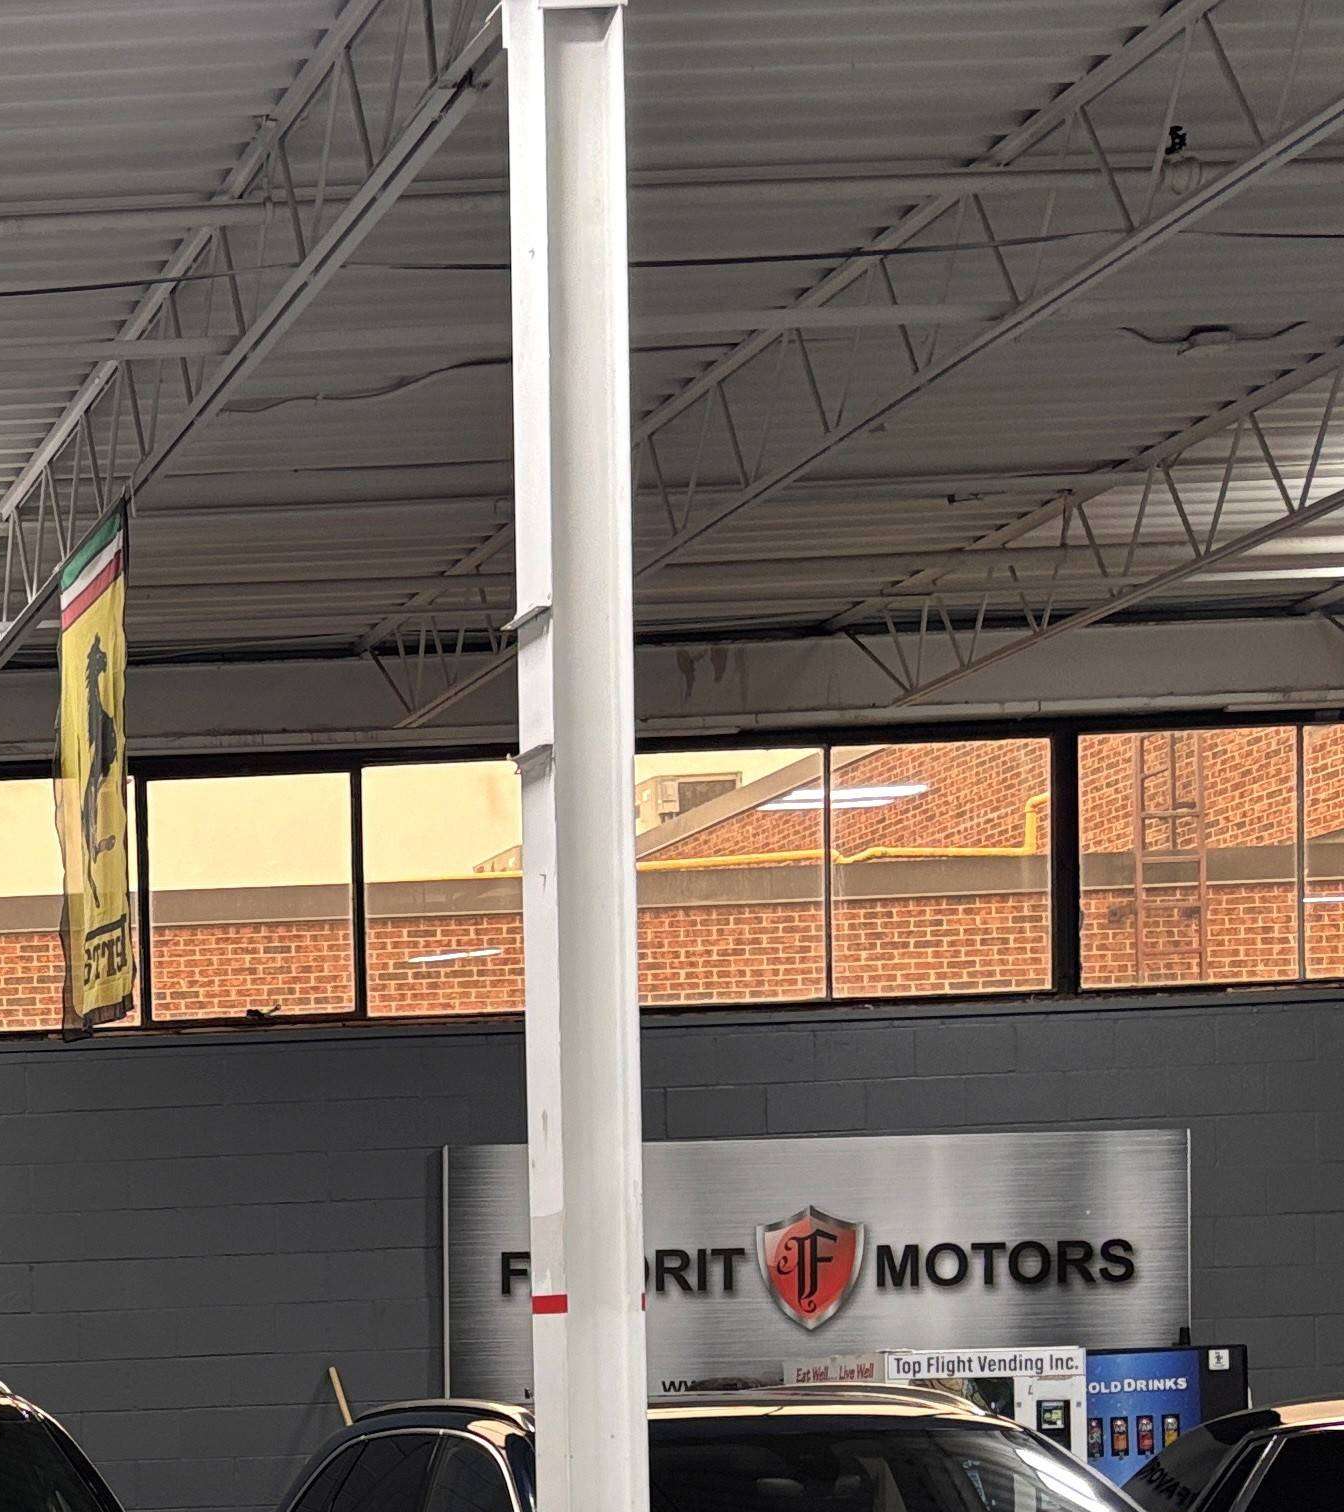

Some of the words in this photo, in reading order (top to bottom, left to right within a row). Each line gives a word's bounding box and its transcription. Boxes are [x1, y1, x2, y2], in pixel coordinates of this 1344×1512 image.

[501, 1248, 745, 1294] FRIT
[876, 1239, 1135, 1288] MOTORS
[893, 1356, 922, 1377] Top
[926, 1353, 974, 1377] Flight
[977, 1353, 1045, 1375] Vending
[1049, 1353, 1080, 1372] Inc.
[1088, 1380, 1121, 1394] OLD
[1123, 1377, 1188, 1392] DRINKS
